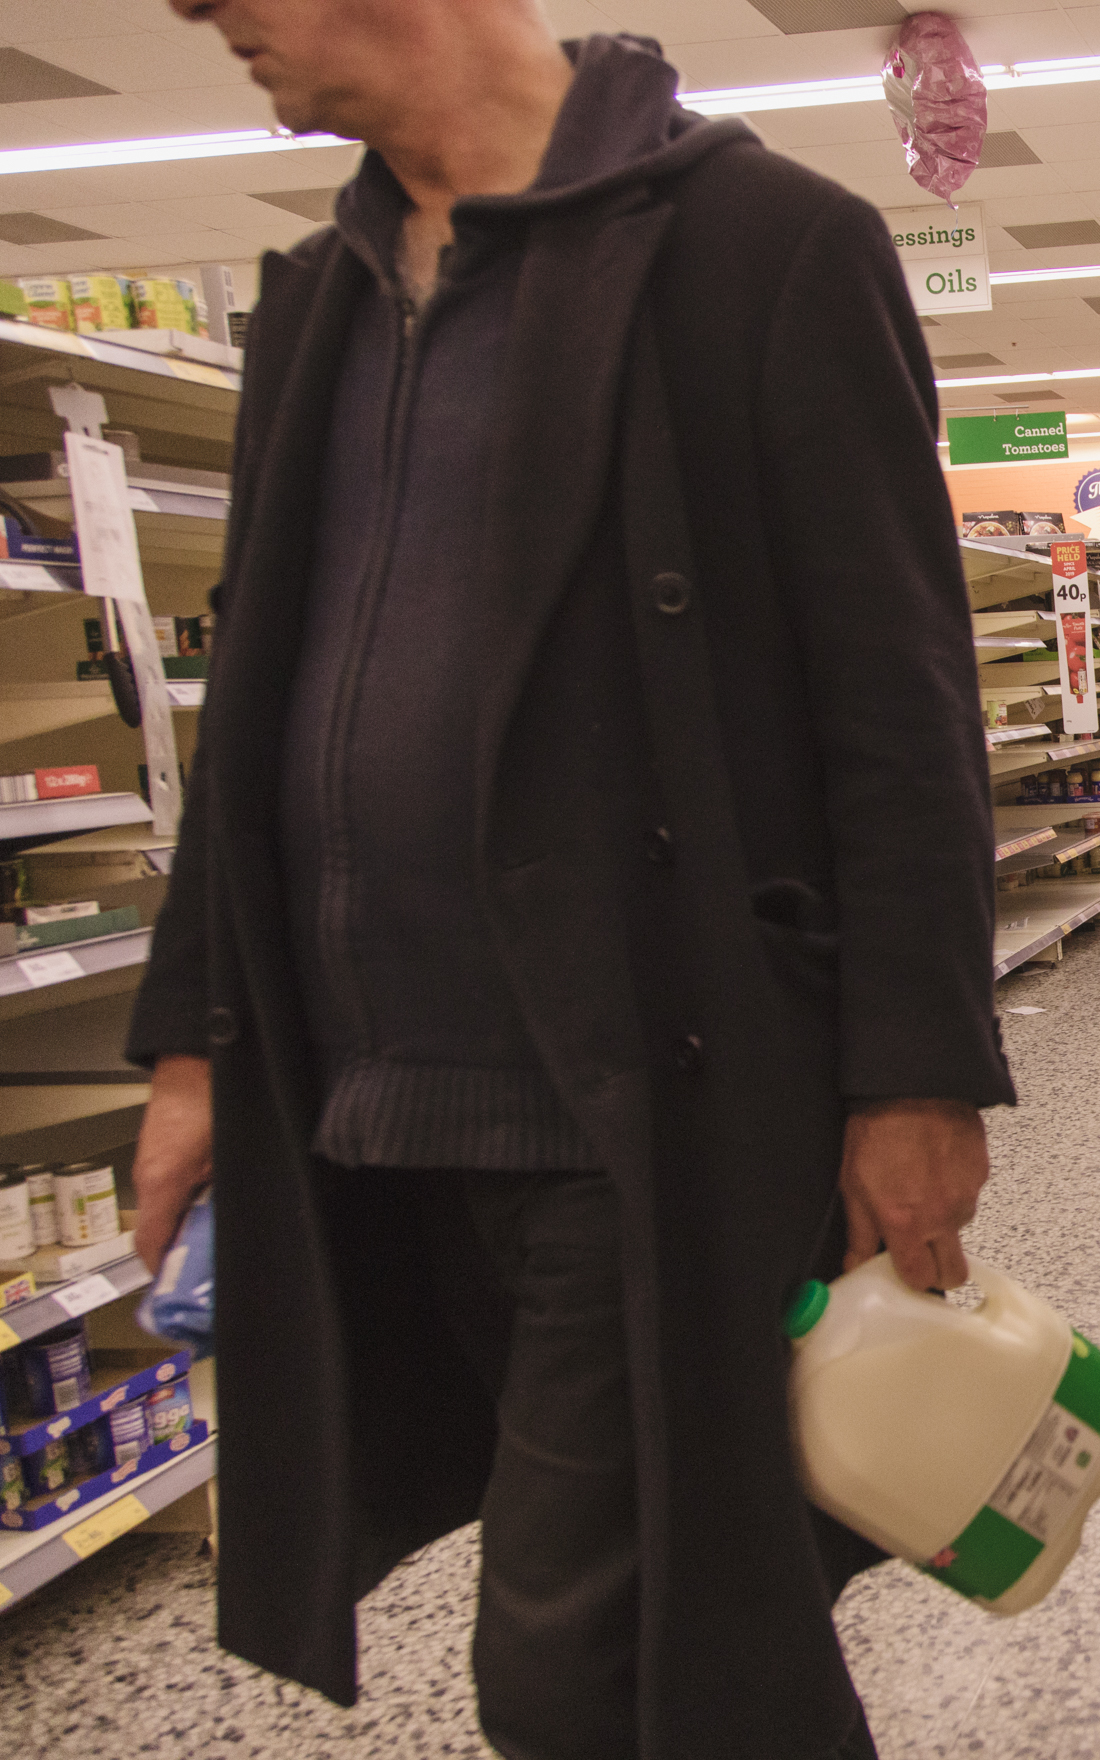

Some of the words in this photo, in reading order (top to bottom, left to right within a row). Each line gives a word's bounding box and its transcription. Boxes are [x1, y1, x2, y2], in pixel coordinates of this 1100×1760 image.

[890, 225, 976, 248] essings
[925, 268, 978, 295] Oils
[1014, 423, 1064, 438] Canned
[1002, 442, 1066, 455] Tomatoes
[1056, 545, 1080, 554] PRICE
[1057, 553, 1081, 562] HELD
[1056, 584, 1087, 602] 40p
